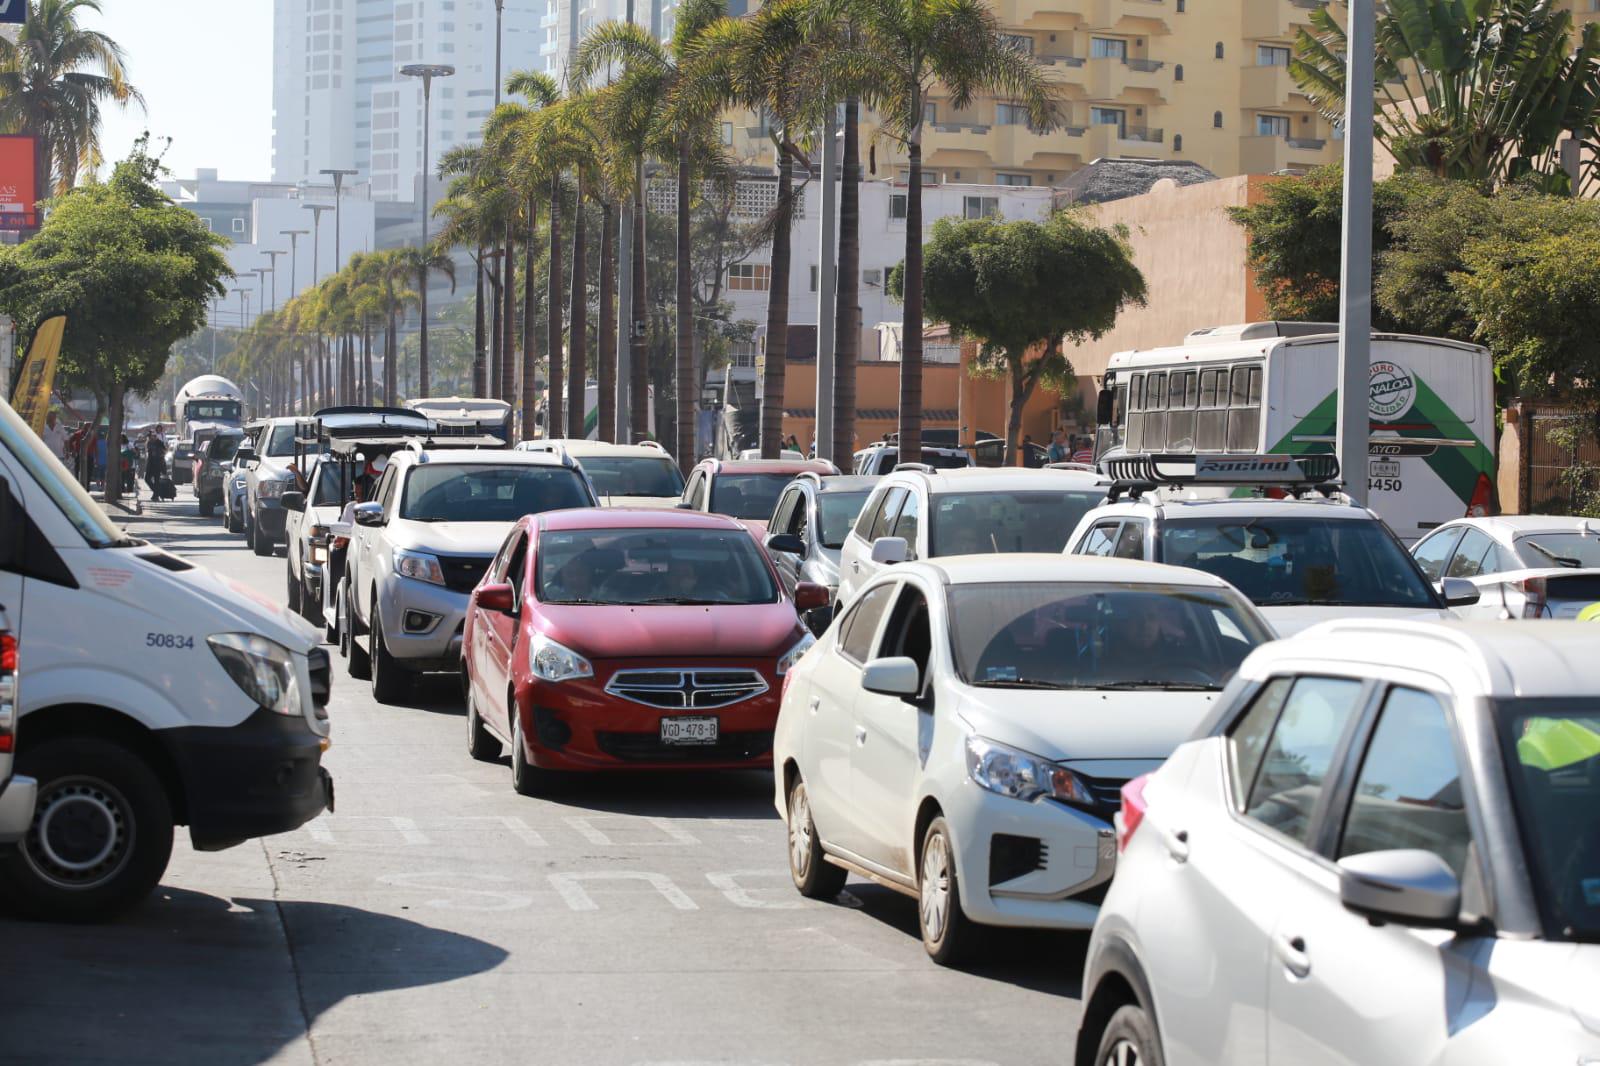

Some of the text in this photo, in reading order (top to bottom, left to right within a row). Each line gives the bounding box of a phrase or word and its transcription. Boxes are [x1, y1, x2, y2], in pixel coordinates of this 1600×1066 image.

[1369, 378, 1410, 396] NALOA
[1369, 396, 1406, 413] CALIDAD
[146, 632, 195, 650] 50834
